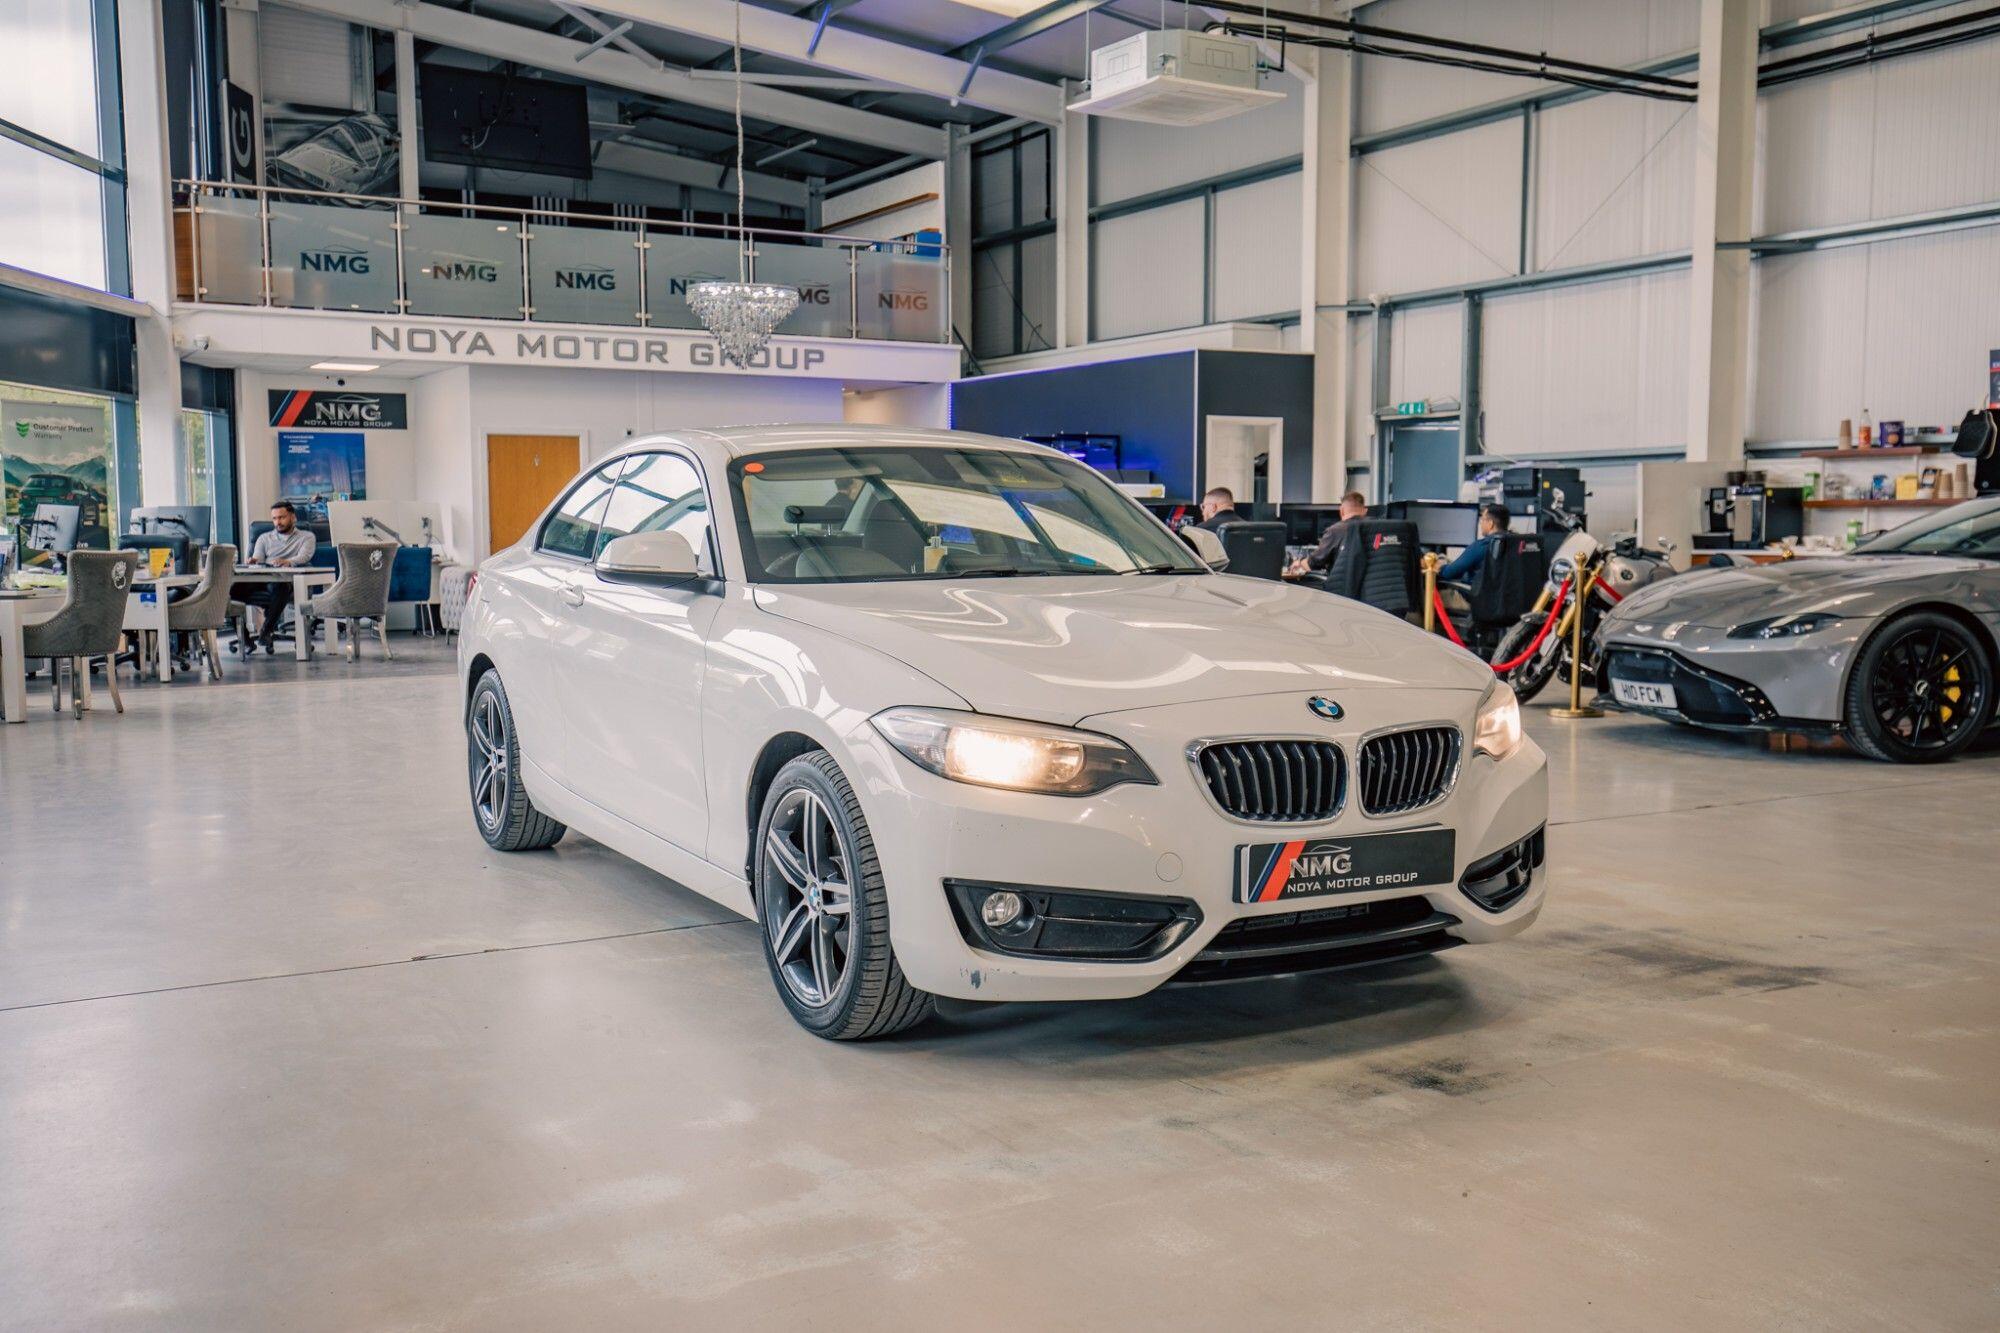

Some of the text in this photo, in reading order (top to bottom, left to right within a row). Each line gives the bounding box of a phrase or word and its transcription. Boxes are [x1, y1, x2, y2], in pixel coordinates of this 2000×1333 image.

[301, 252, 369, 274] NMG
[433, 263, 497, 282] NMG
[555, 270, 616, 290] NMG
[797, 288, 830, 304] MG
[878, 293, 928, 310] NMG
[371, 326, 494, 355] NOYA
[517, 333, 669, 364] MOTOR
[316, 402, 381, 420] NMG
[33, 423, 94, 433] Customer Protect
[33, 432, 62, 440] Warranty
[1289, 853, 1352, 879] NMG
[1287, 872, 1418, 893] NOYA MOTOR GROUP
